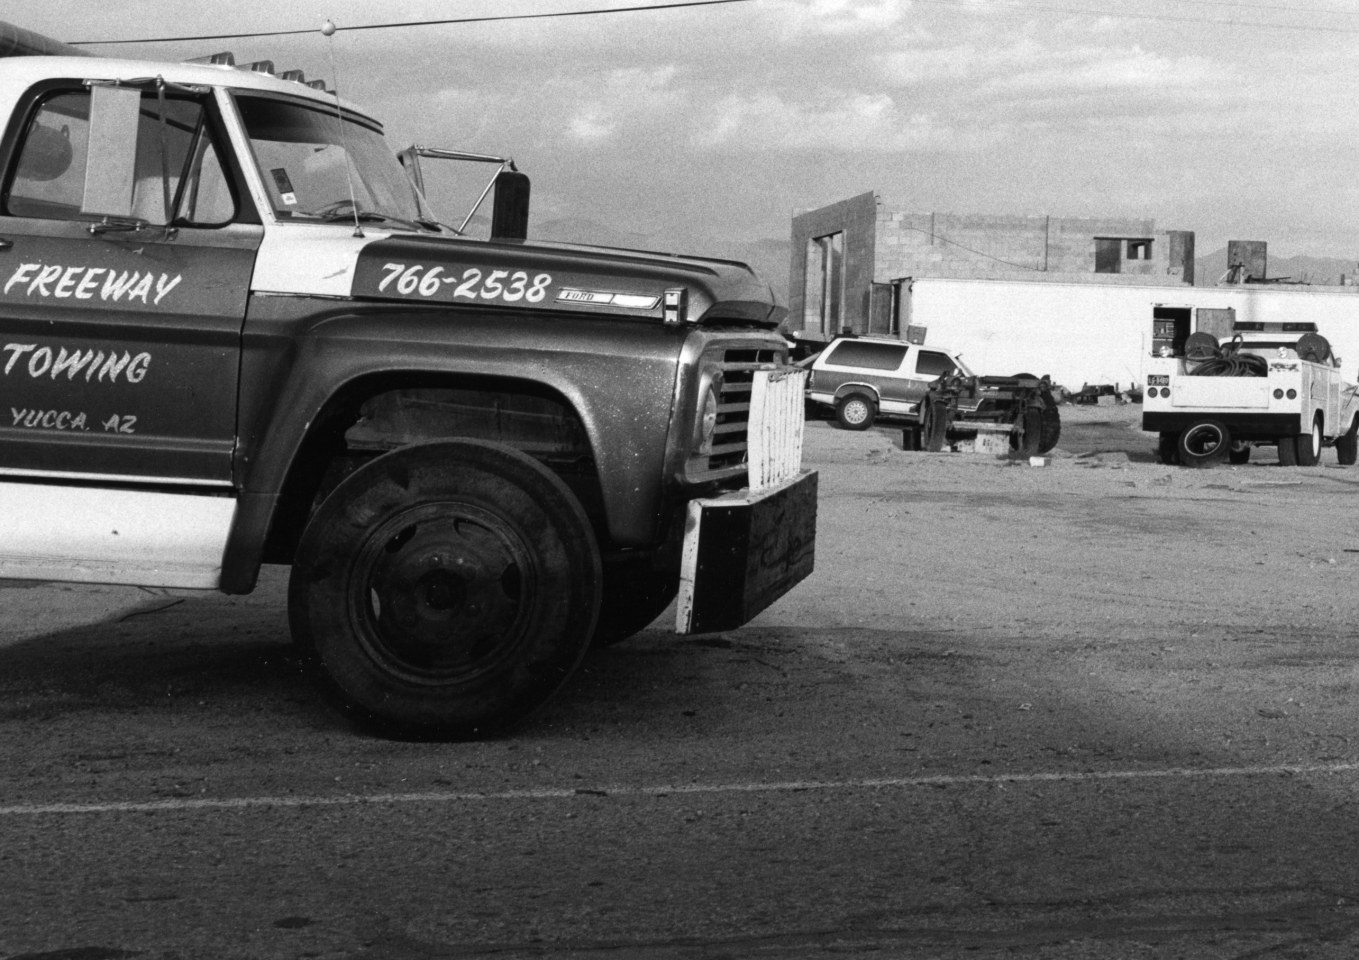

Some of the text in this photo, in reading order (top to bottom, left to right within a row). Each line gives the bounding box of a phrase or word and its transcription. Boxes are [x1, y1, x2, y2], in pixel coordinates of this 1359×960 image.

[4, 263, 182, 305] FREEWAY
[378, 262, 552, 303] 766-2538
[565, 291, 595, 301] FORD
[3, 343, 151, 384] TOWING
[102, 413, 137, 434] AZ
